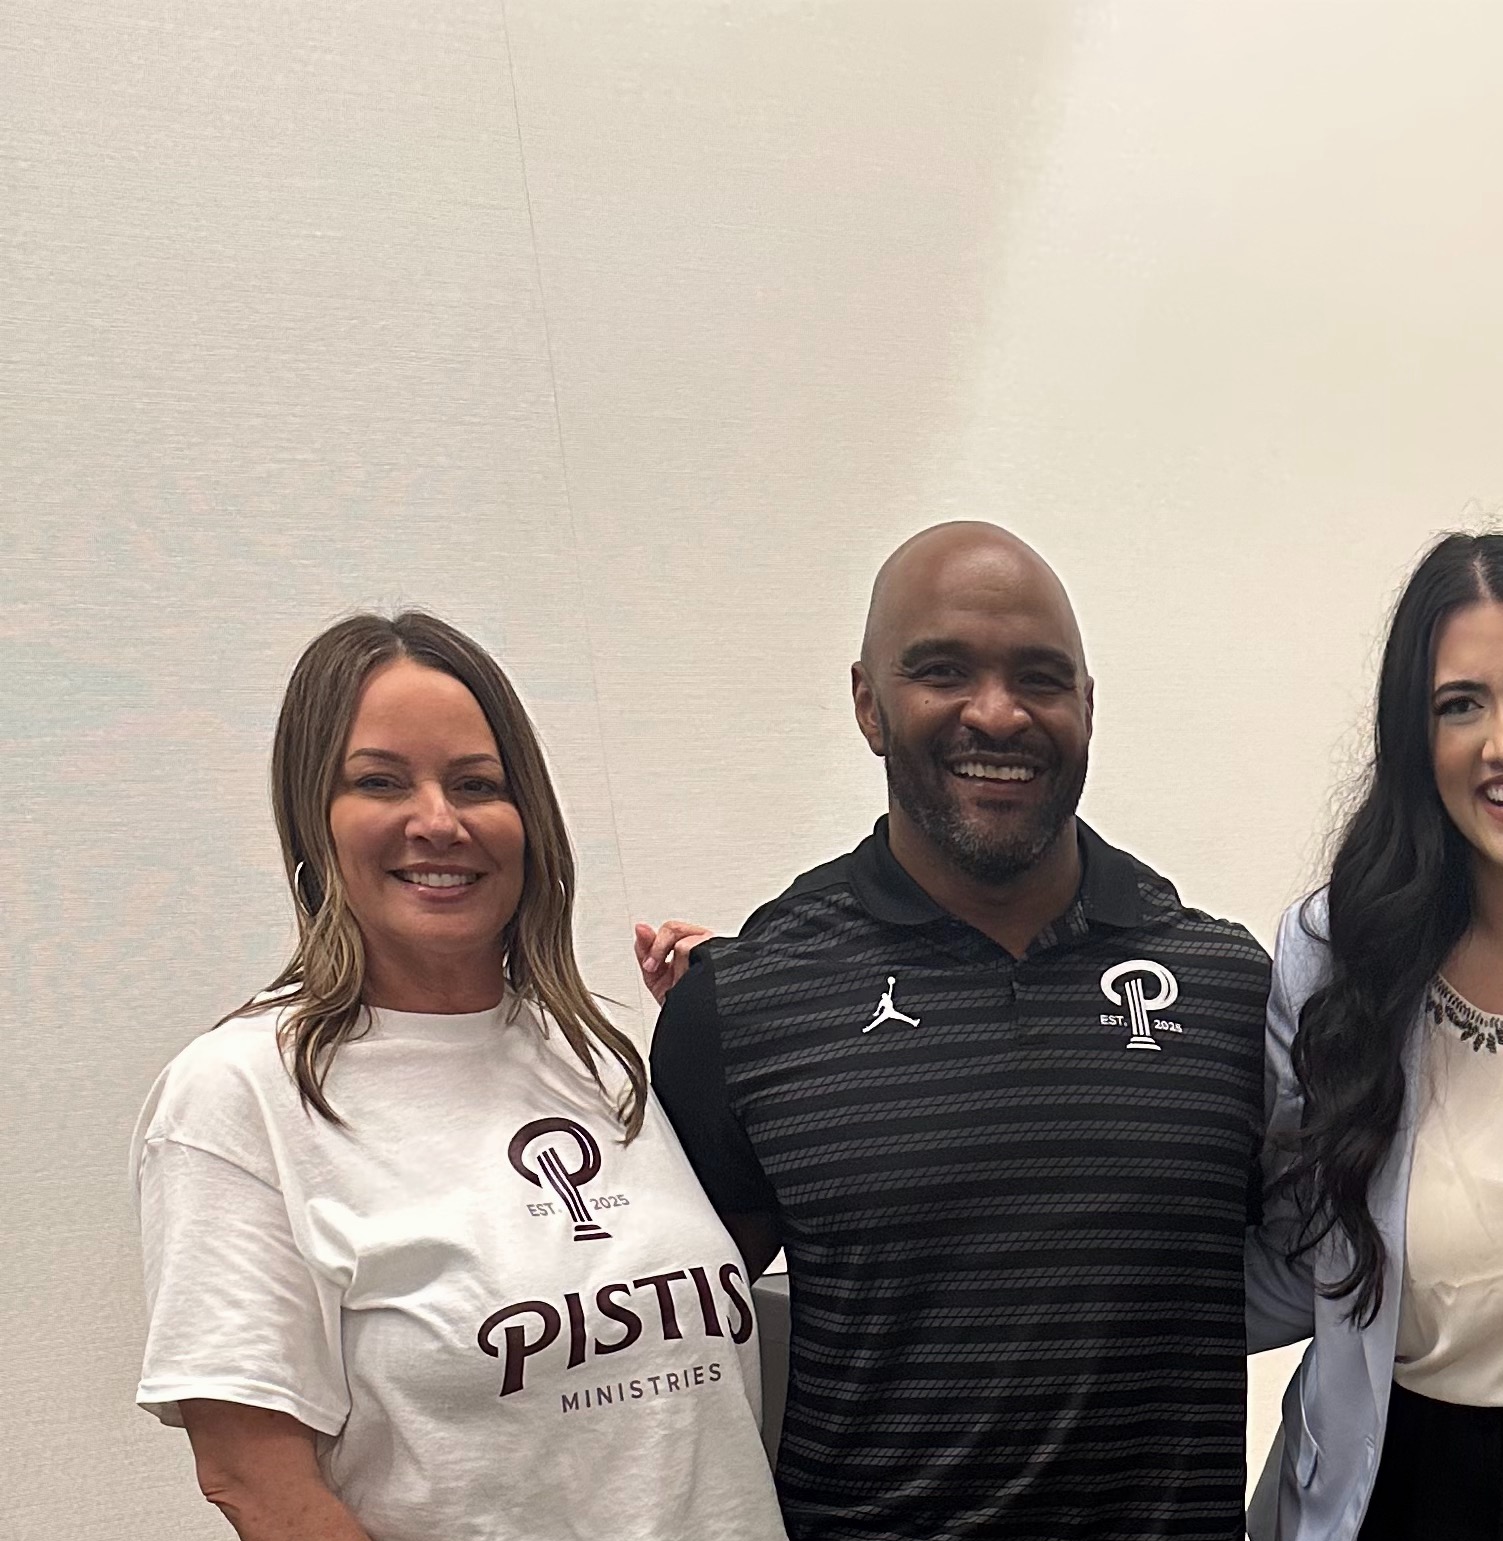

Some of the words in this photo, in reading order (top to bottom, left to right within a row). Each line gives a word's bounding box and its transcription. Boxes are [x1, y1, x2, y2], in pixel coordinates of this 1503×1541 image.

[1100, 1014, 1128, 1027] EST.
[1153, 1019, 1183, 1033] 2025
[526, 1203, 563, 1218] EST.
[589, 1194, 630, 1211] 2025
[477, 1263, 753, 1398] PISTIS
[561, 1363, 722, 1413] MINISTRIES
